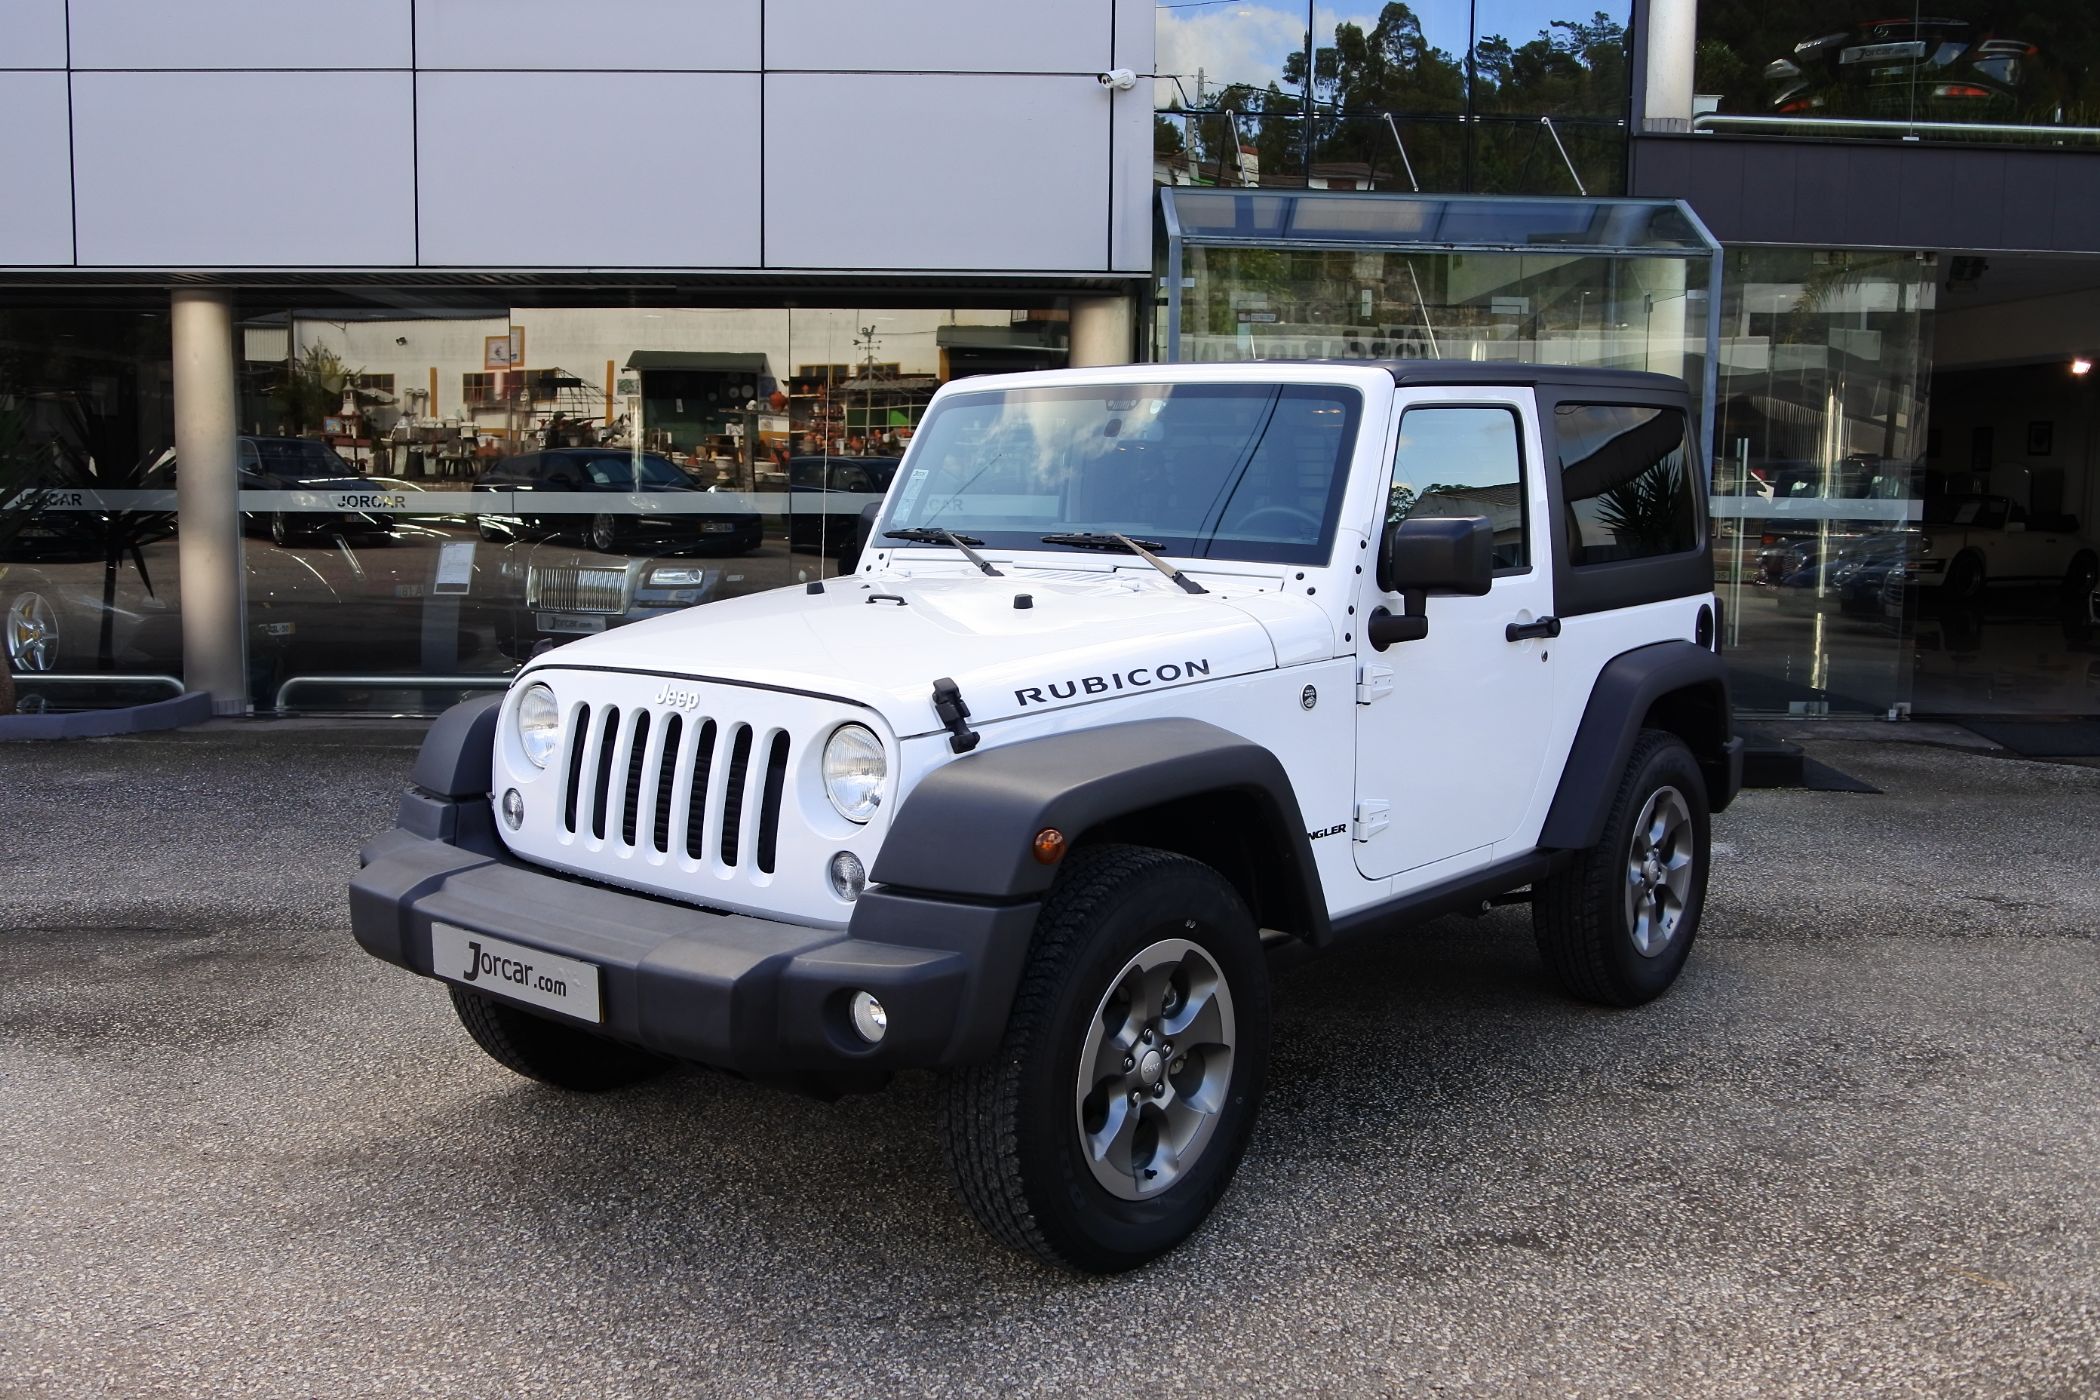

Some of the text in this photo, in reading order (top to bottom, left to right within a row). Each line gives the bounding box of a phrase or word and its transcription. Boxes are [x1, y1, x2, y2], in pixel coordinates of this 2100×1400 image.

[16, 492, 82, 507] JCAR
[337, 494, 406, 508] JORCAR
[655, 681, 701, 713] Jeep
[1014, 658, 1211, 706] RUBICON
[463, 941, 568, 998] Jorcar.com
